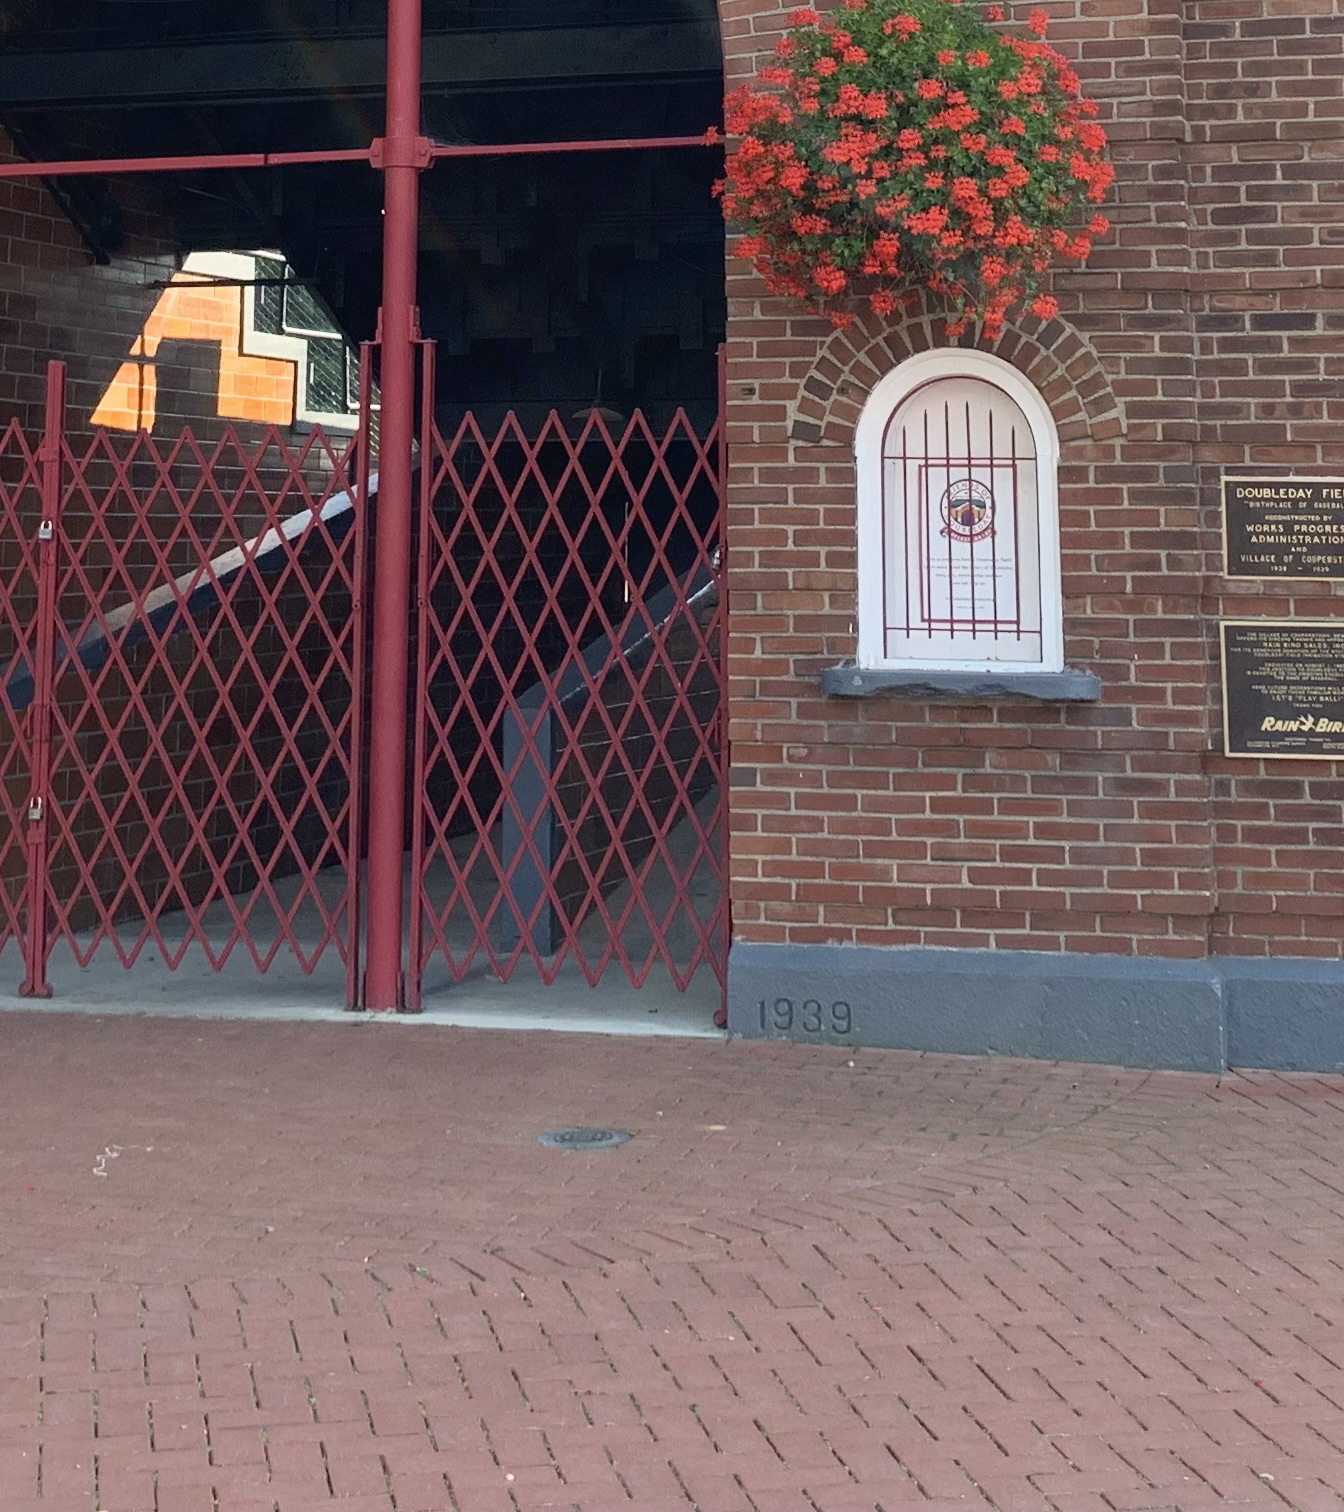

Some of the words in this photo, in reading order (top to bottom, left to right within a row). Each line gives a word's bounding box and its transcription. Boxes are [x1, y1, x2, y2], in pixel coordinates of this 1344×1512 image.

[1236, 487, 1313, 498] DOUBLEDAY
[1246, 524, 1284, 532] WORKS
[1240, 555, 1276, 563] VILLAGE
[1283, 555, 1293, 563] OF
[1261, 716, 1300, 732] RAIN
[757, 998, 852, 1034] 1939
